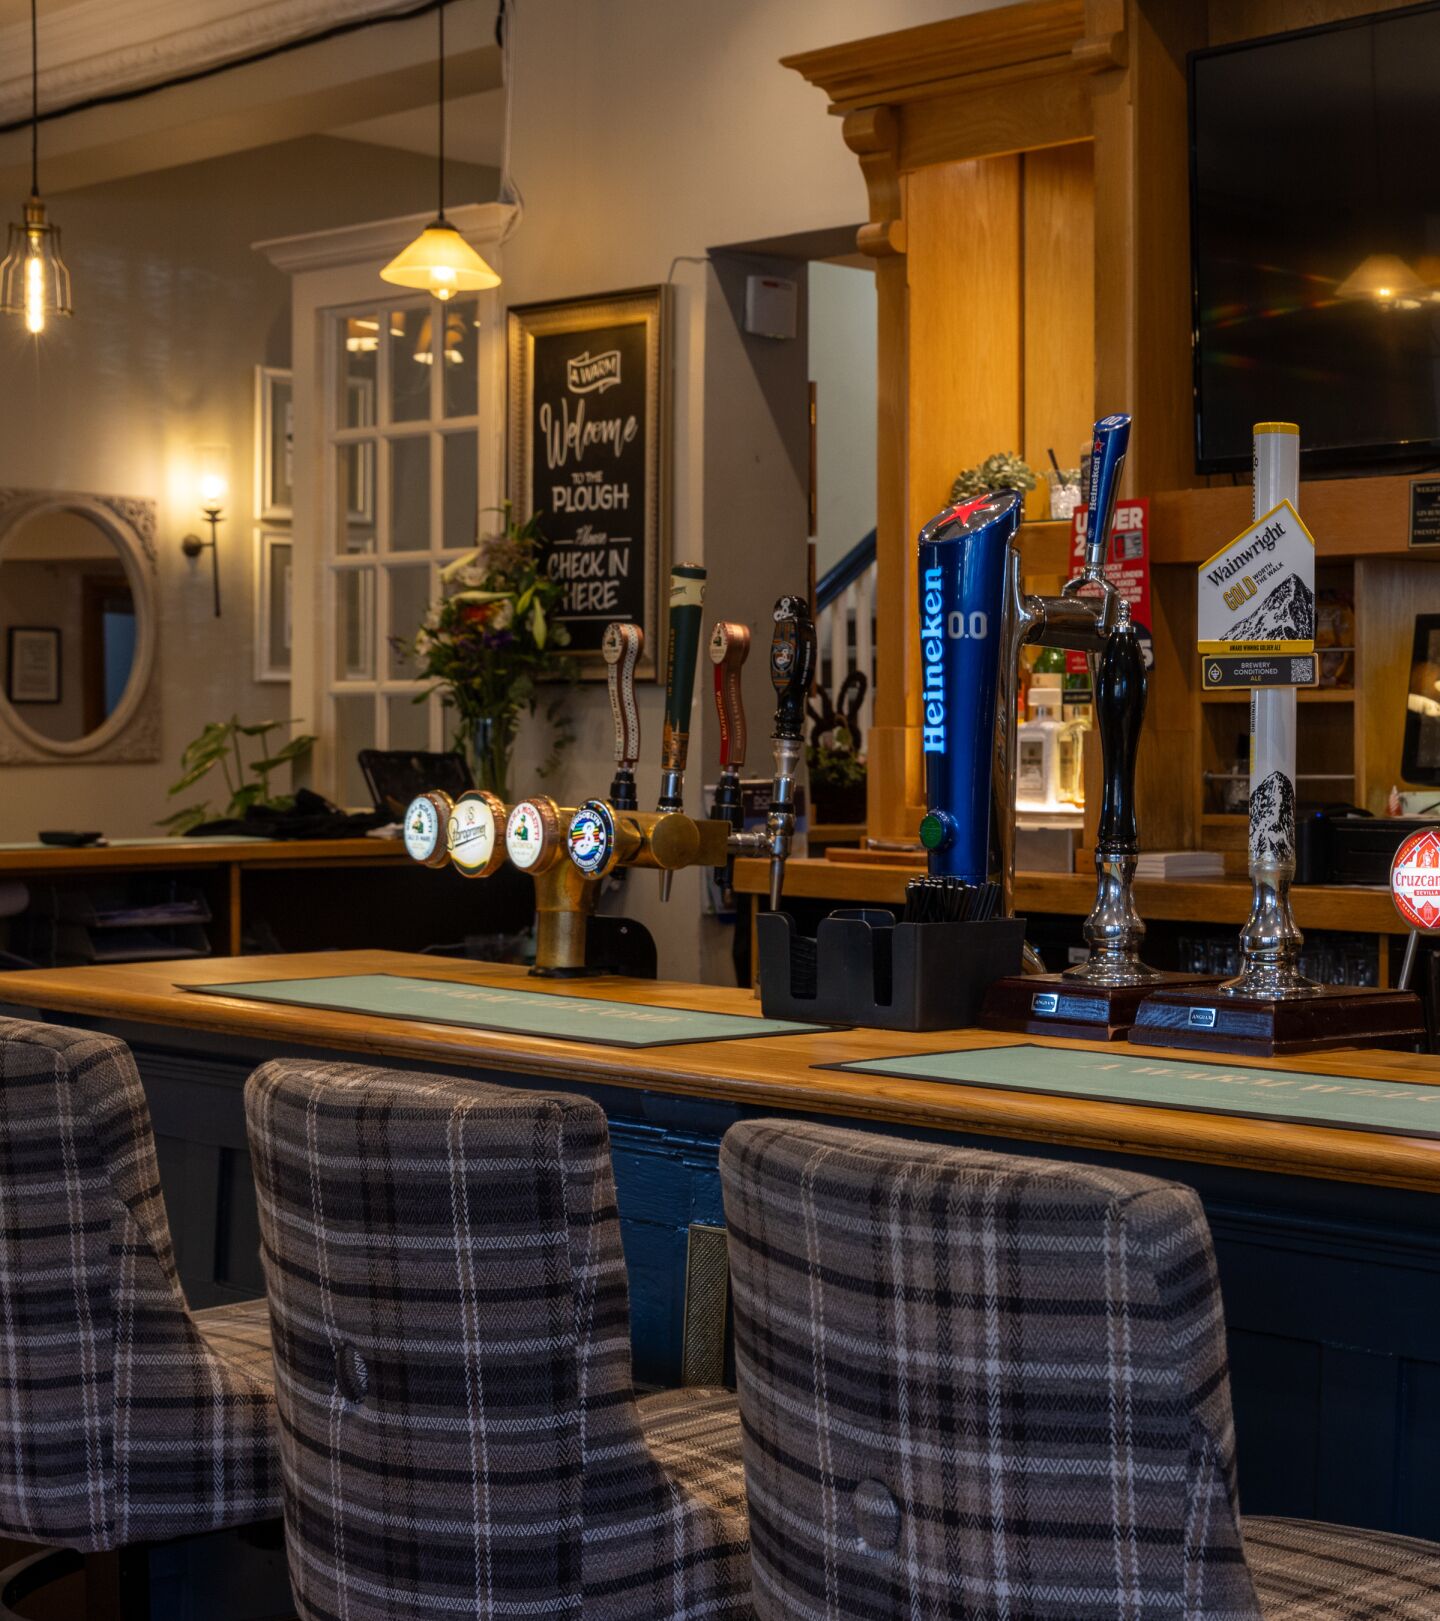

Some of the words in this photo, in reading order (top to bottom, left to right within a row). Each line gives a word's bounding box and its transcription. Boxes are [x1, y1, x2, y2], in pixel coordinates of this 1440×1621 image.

[582, 359, 617, 382] WARM
[540, 398, 638, 470] Welcome
[572, 473, 584, 484] TO
[585, 471, 603, 483] THE
[1089, 457, 1101, 511] Heineken
[552, 484, 629, 513] PLOUGH
[548, 555, 604, 580] CHECK
[609, 550, 628, 578] IN
[1206, 522, 1286, 587] Wainwright
[1252, 562, 1274, 581] WORTH
[1256, 575, 1267, 586] THE
[1267, 562, 1285, 580] WALK
[563, 580, 620, 610] HERE
[1223, 575, 1258, 611] GOLD
[948, 611, 988, 639] 0.0
[923, 566, 945, 754] Heineken
[1233, 668, 1278, 676] CONDITIONED
